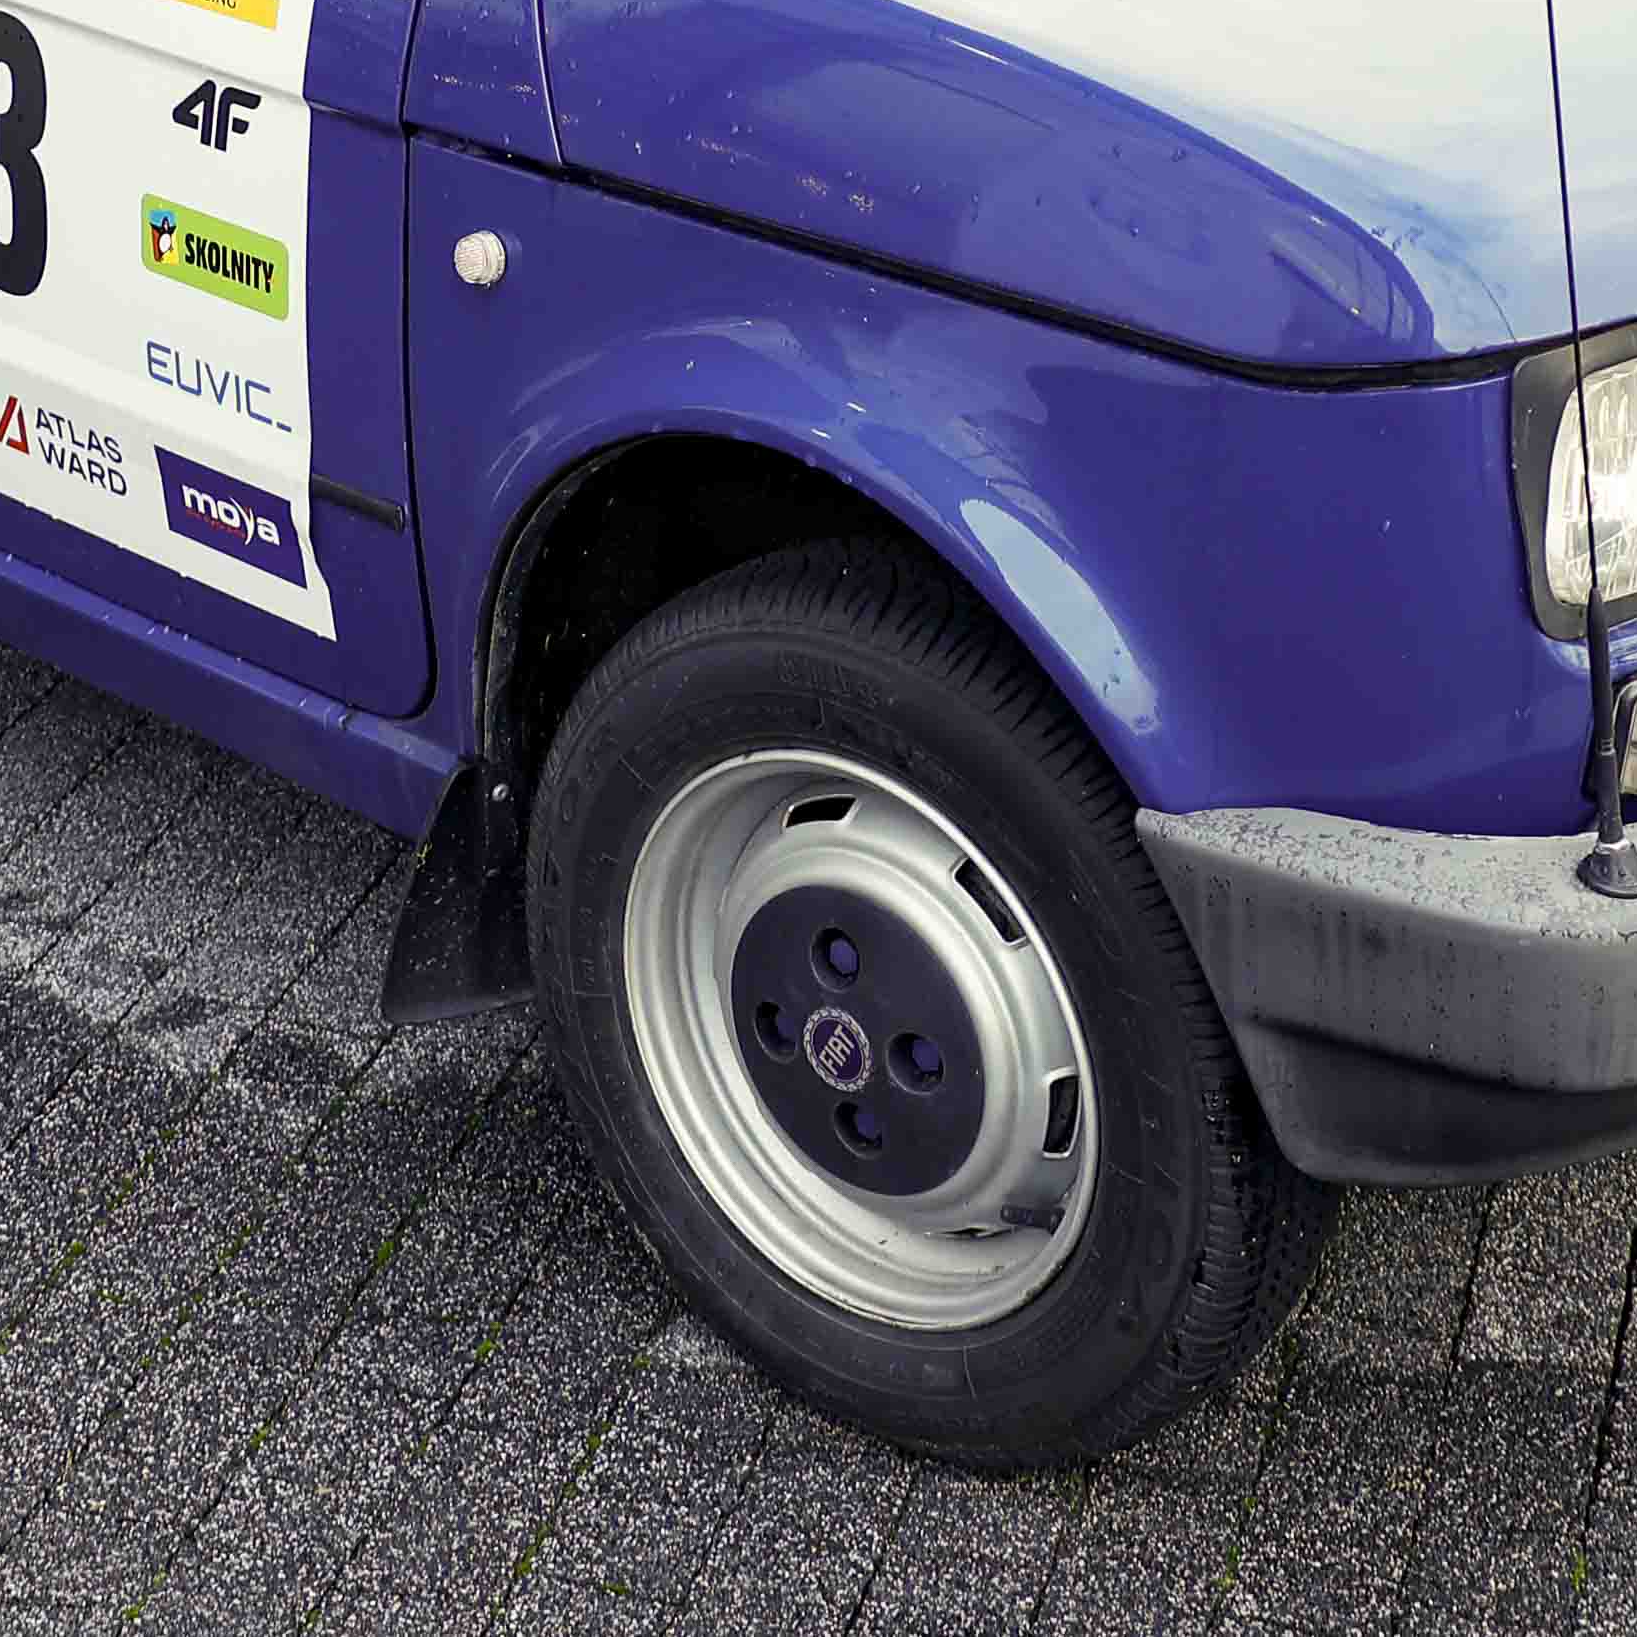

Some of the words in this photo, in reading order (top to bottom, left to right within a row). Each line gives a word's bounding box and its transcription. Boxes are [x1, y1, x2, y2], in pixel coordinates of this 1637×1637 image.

[173, 79, 261, 151] 4F
[184, 233, 275, 295] SKOLNITY
[35, 407, 123, 464] ATLAS
[38, 440, 127, 497] WARD
[182, 485, 281, 547] moya
[819, 1024, 855, 1076] FIAT
